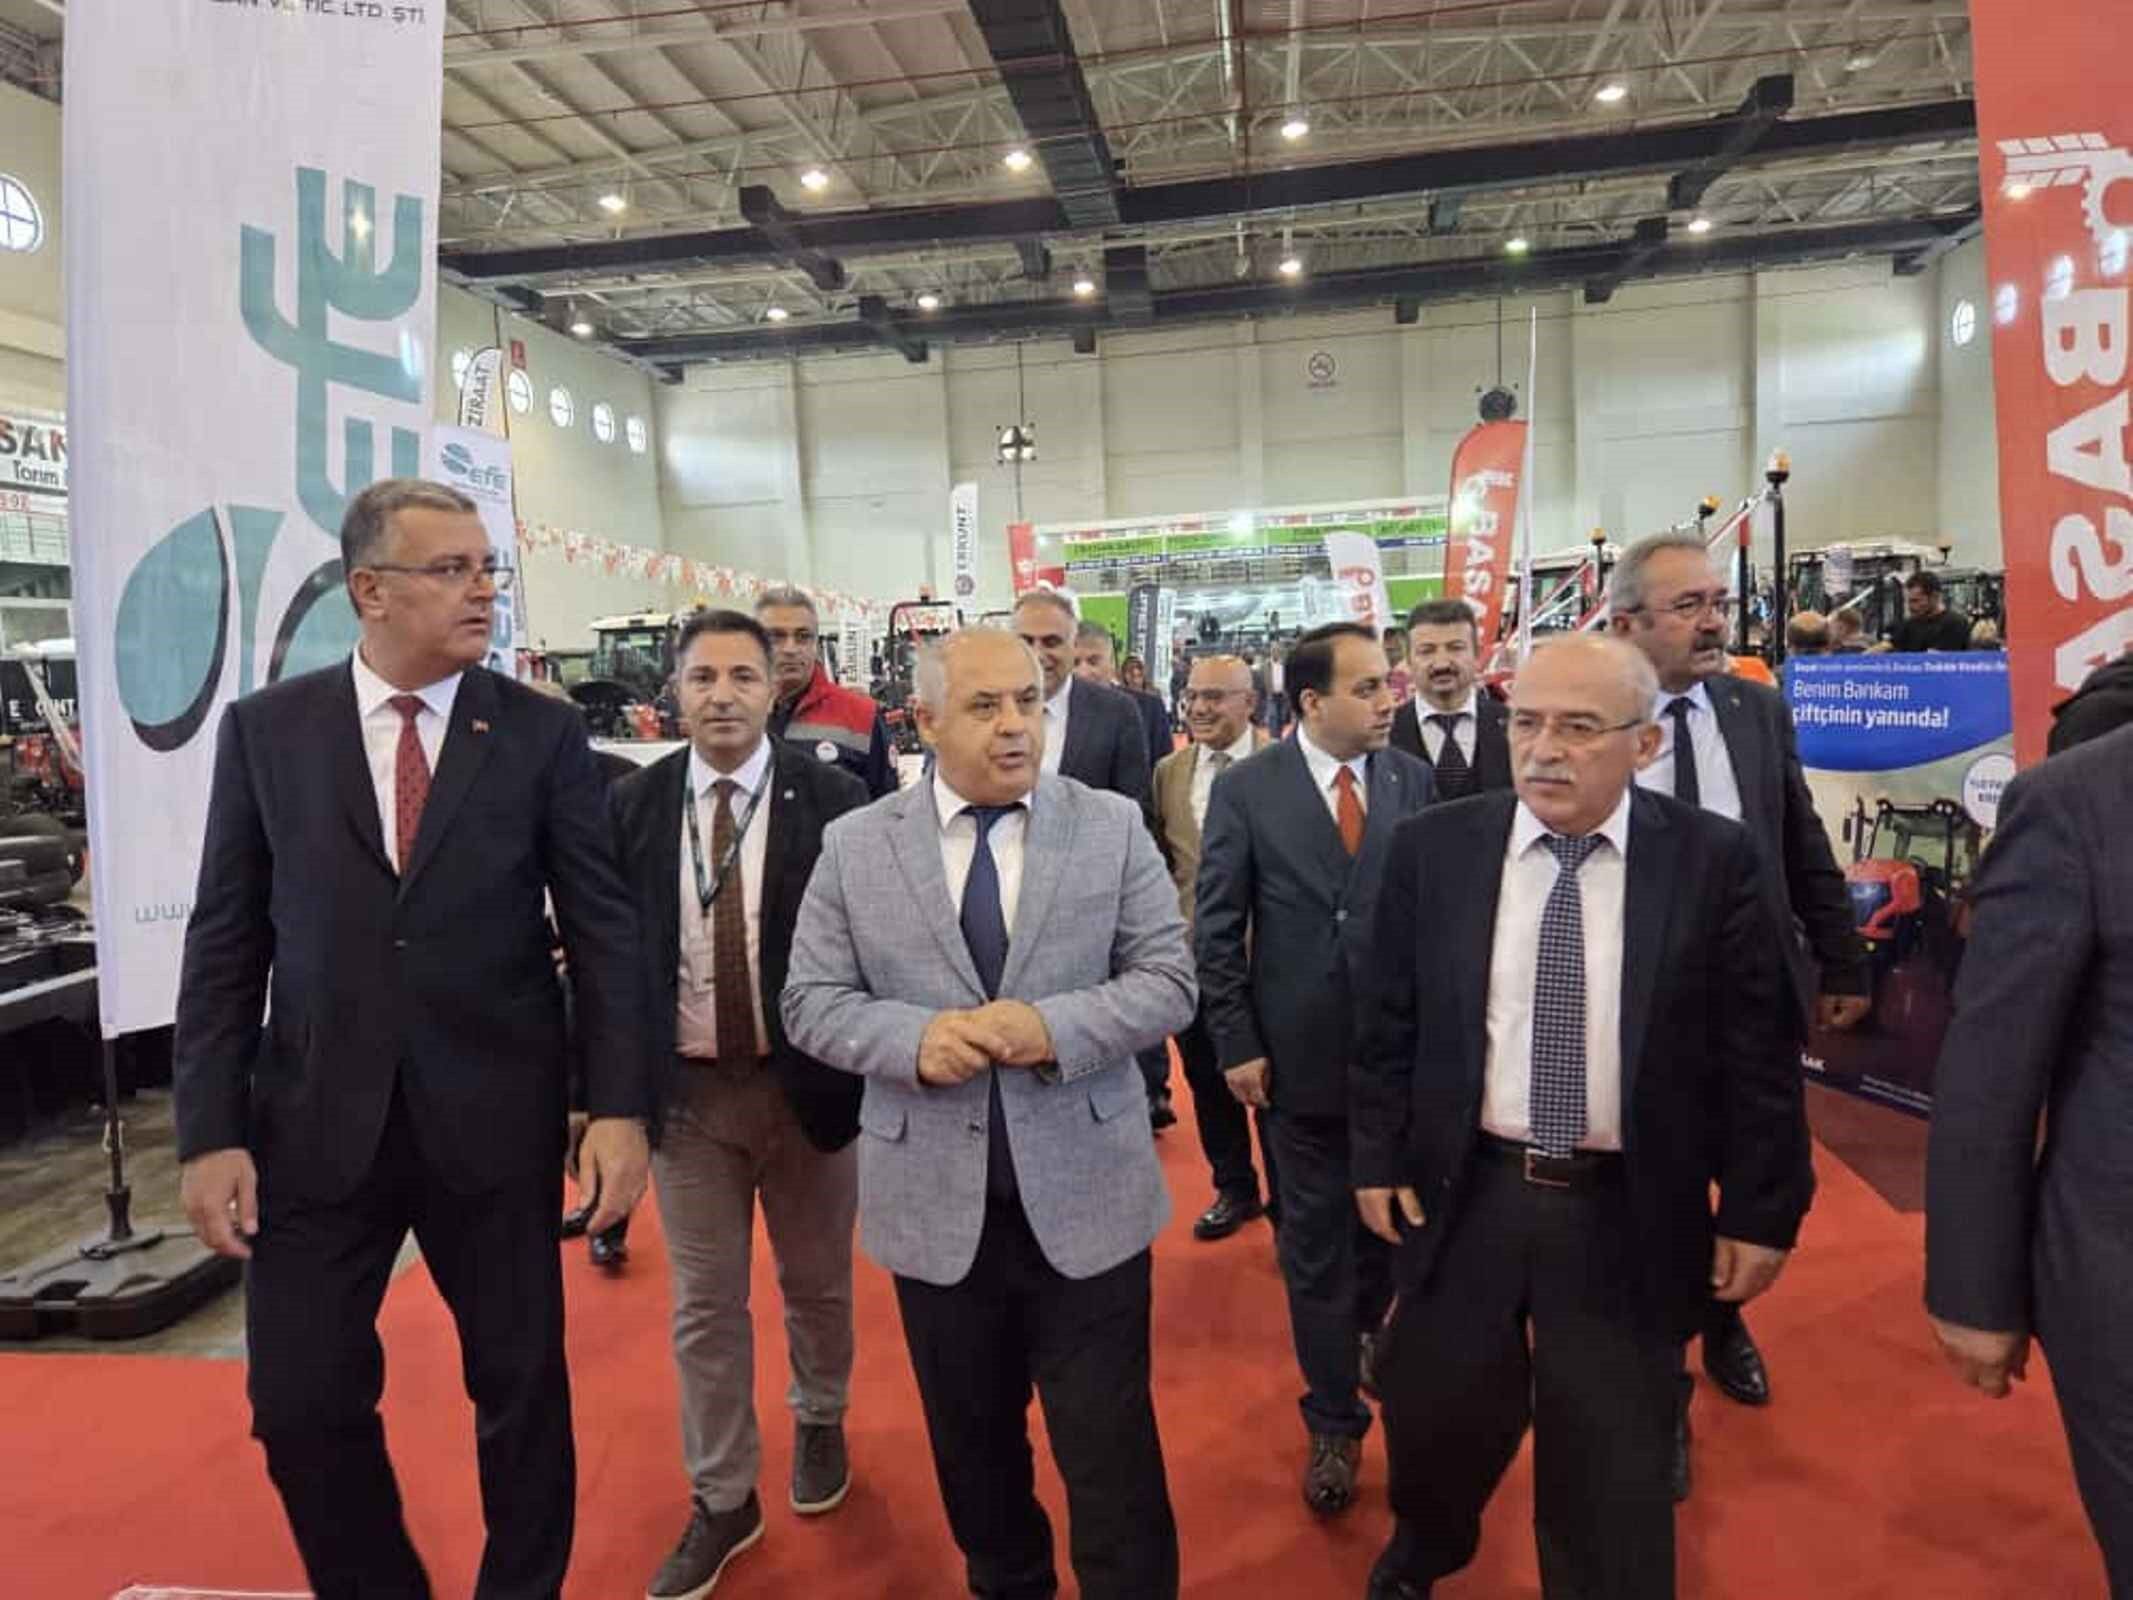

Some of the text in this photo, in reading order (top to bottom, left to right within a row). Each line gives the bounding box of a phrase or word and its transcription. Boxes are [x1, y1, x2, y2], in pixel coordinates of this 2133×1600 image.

[1793, 679, 1909, 700] Benim Bankam
[1791, 703, 1949, 729] çiftçinin yanında!
